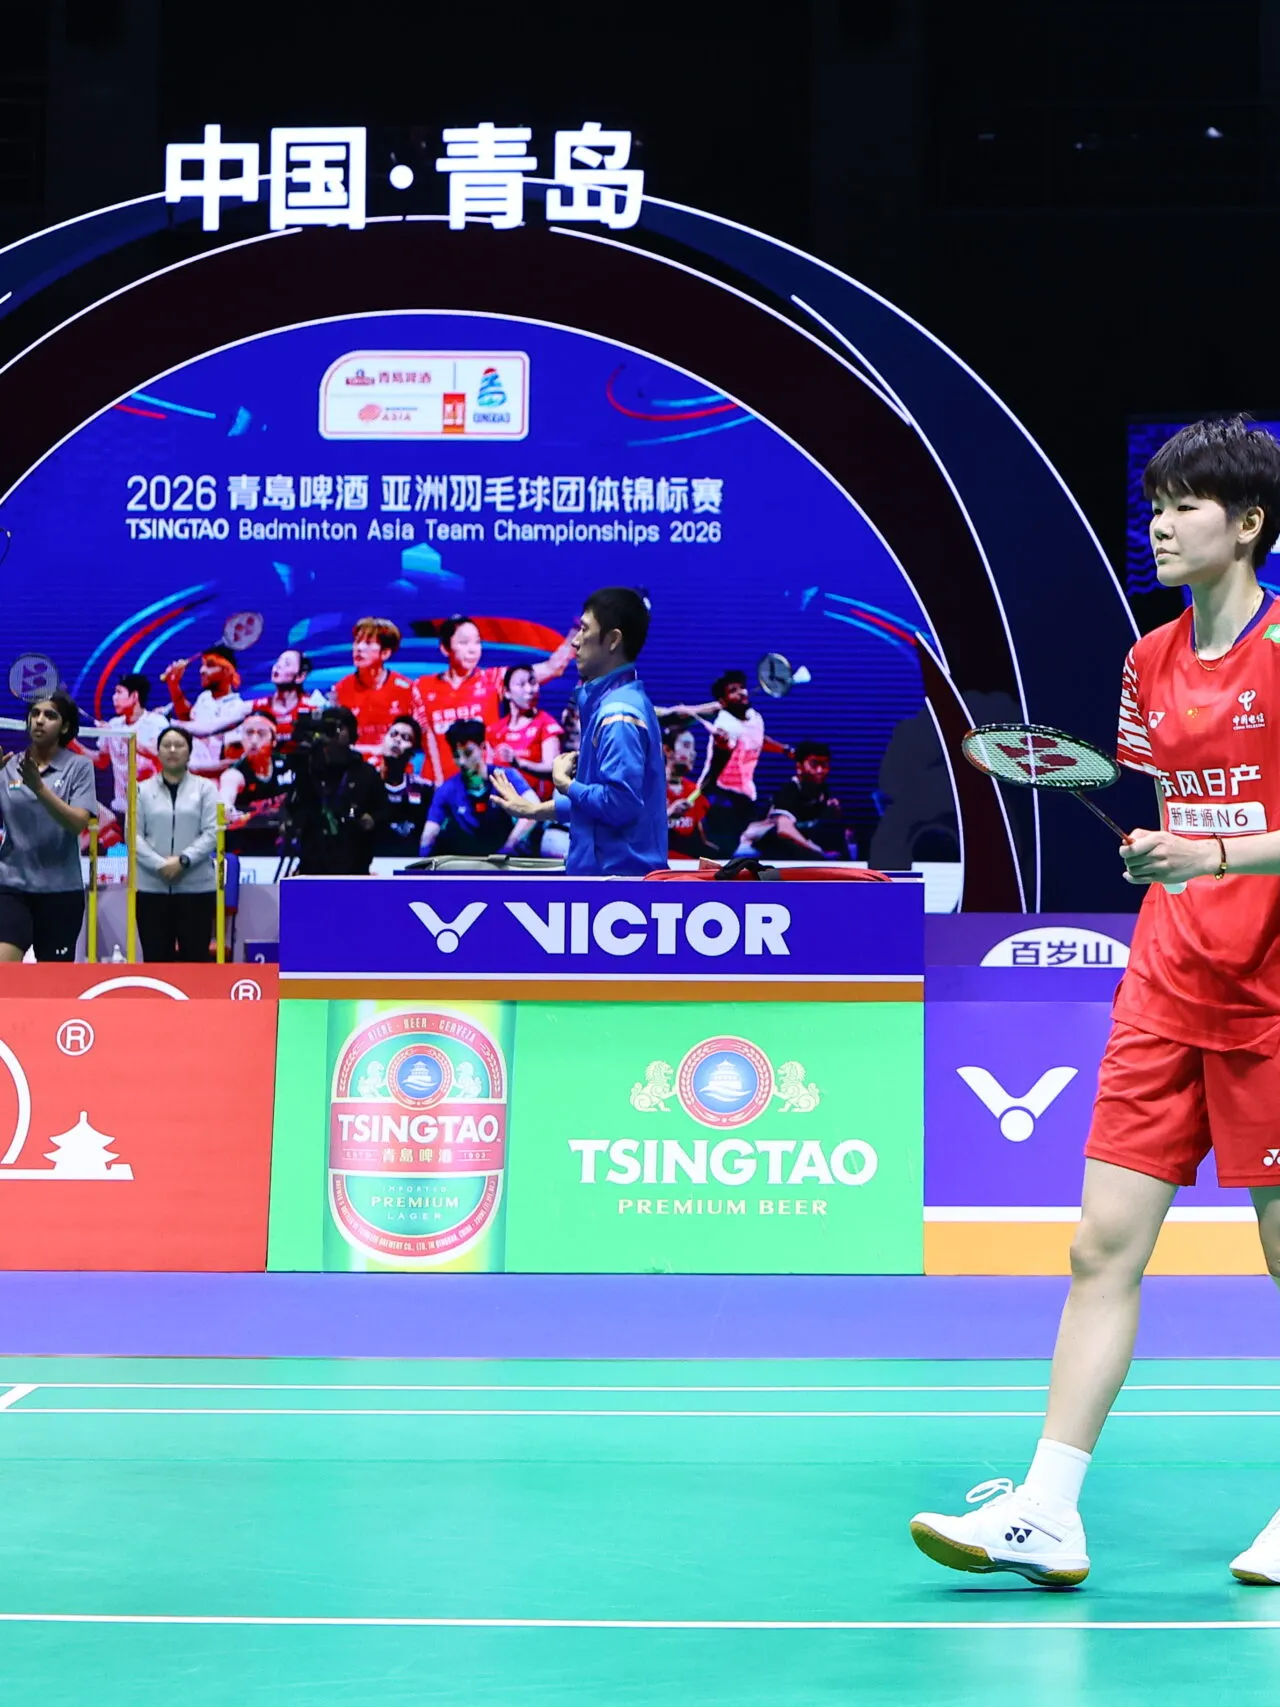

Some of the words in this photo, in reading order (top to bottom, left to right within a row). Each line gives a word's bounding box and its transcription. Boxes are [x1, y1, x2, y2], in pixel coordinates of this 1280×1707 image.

[164, 121, 645, 232] 中国·青岛
[126, 474, 217, 512] 2026
[380, 473, 724, 515] 亚洲羽毛球团体锦标赛
[125, 517, 230, 540] TSINGTAO
[239, 518, 357, 541] Badminton
[367, 518, 415, 541] Asia
[425, 518, 485, 541] Team
[493, 518, 660, 547] Championships
[669, 520, 722, 544] 2026
[502, 900, 792, 957] VICTOR
[1010, 939, 1113, 966] 百岁山
[337, 1113, 500, 1145] TSINGTAO
[567, 1138, 879, 1187] TSINGTAO
[371, 1195, 460, 1209] PREMIUM
[387, 1212, 443, 1221] LAGER
[617, 1198, 751, 1216] PREMIUM
[758, 1198, 829, 1216] BEER
